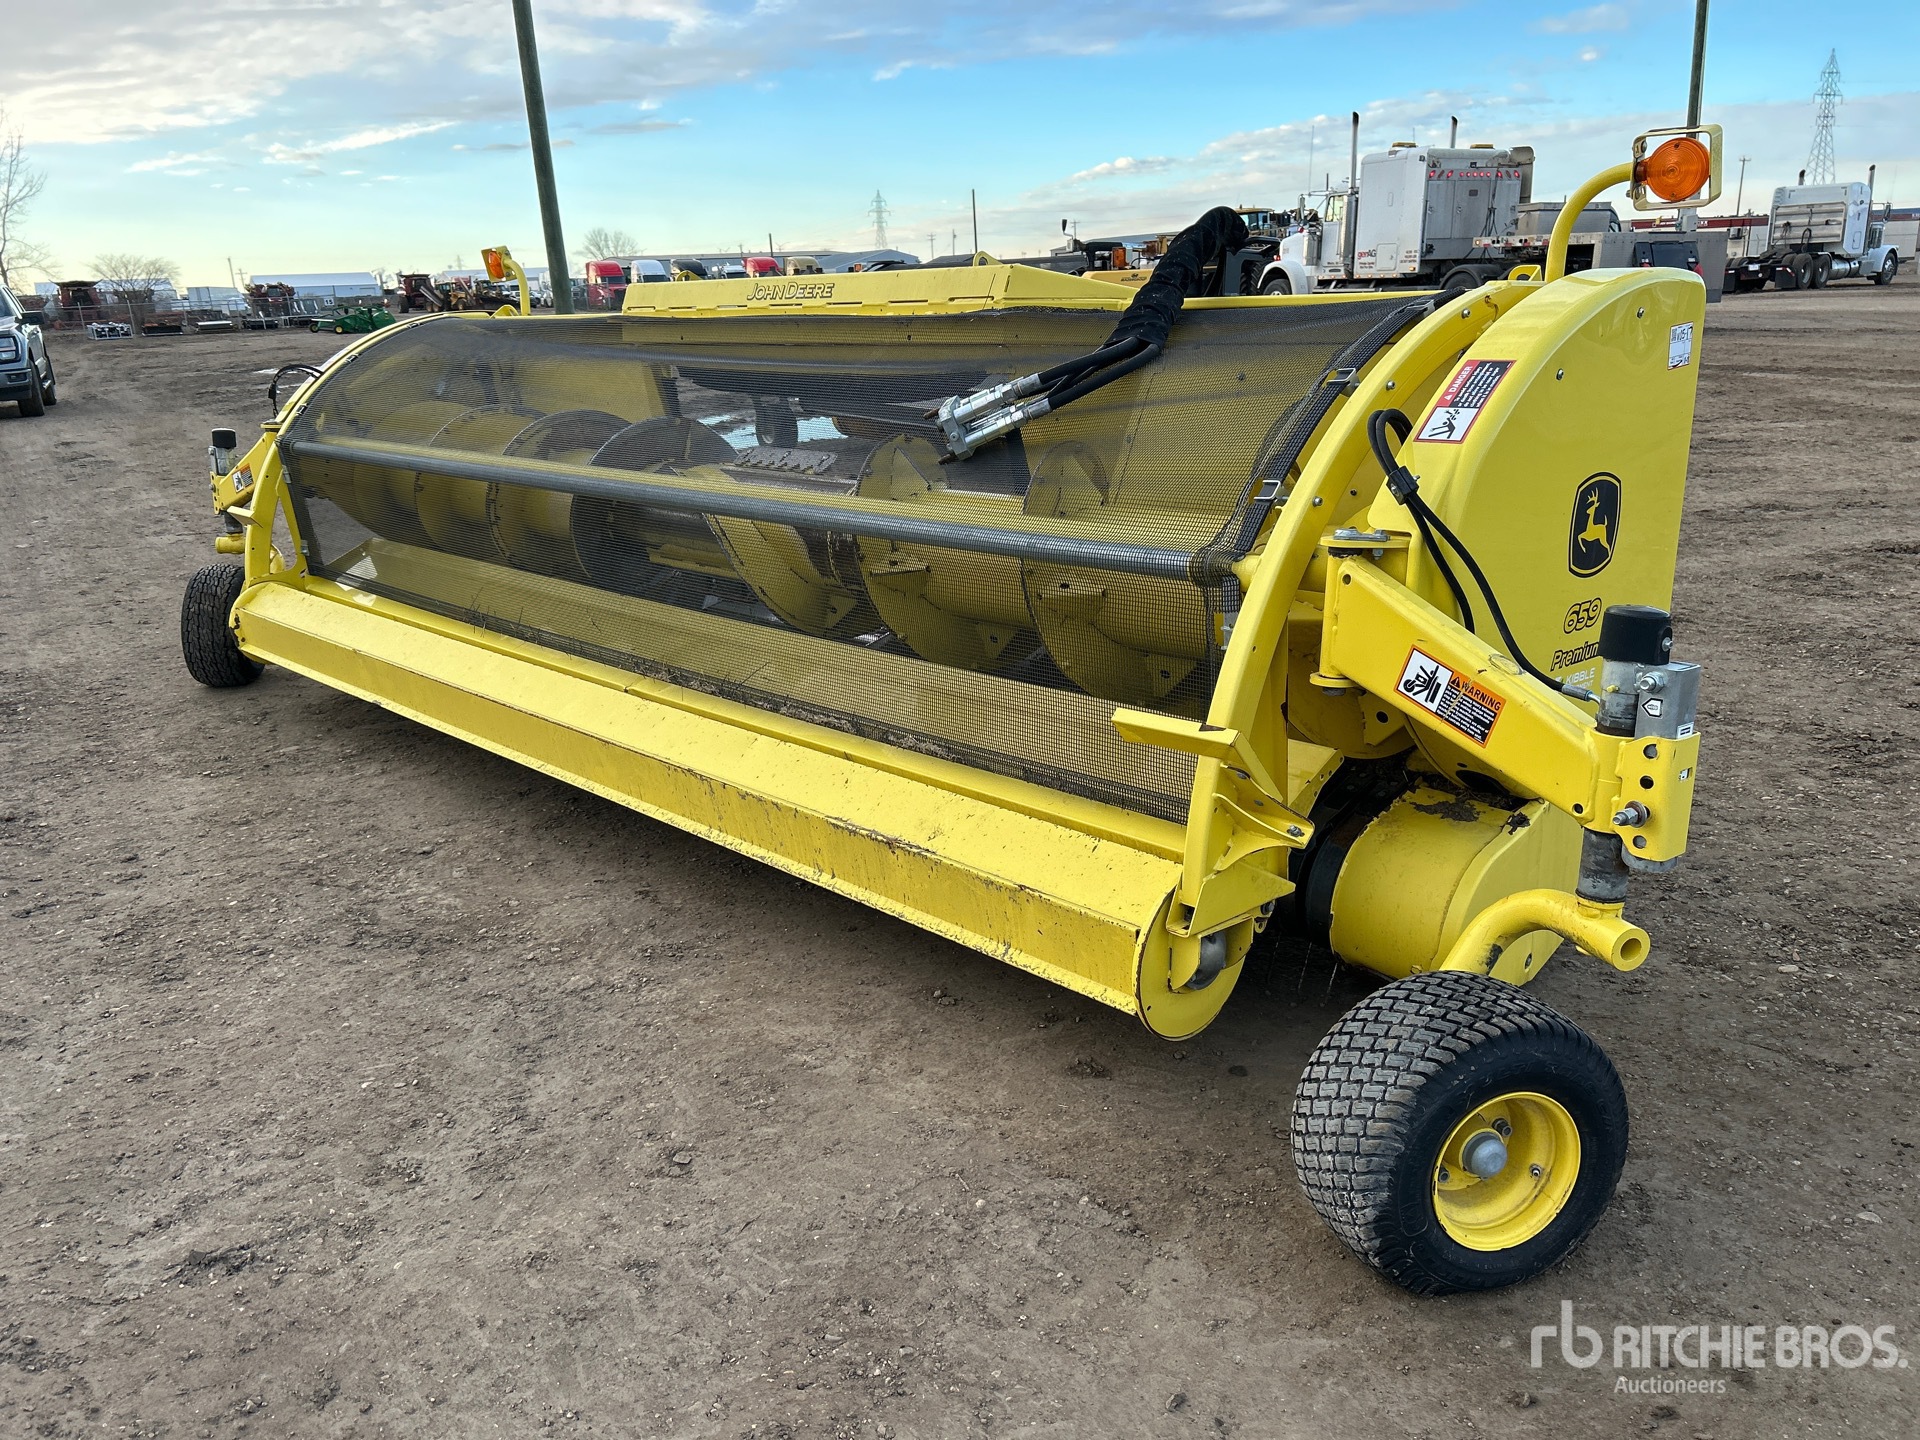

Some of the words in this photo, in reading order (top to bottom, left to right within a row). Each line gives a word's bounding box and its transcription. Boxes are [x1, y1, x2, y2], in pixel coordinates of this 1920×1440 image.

[747, 283, 785, 301] JOHN
[785, 282, 835, 299] DEERE
[1448, 366, 1473, 393] DANGER
[1563, 597, 1602, 634] 659
[1565, 667, 1596, 685] KIBBLE
[1461, 681, 1502, 712] WARNING
